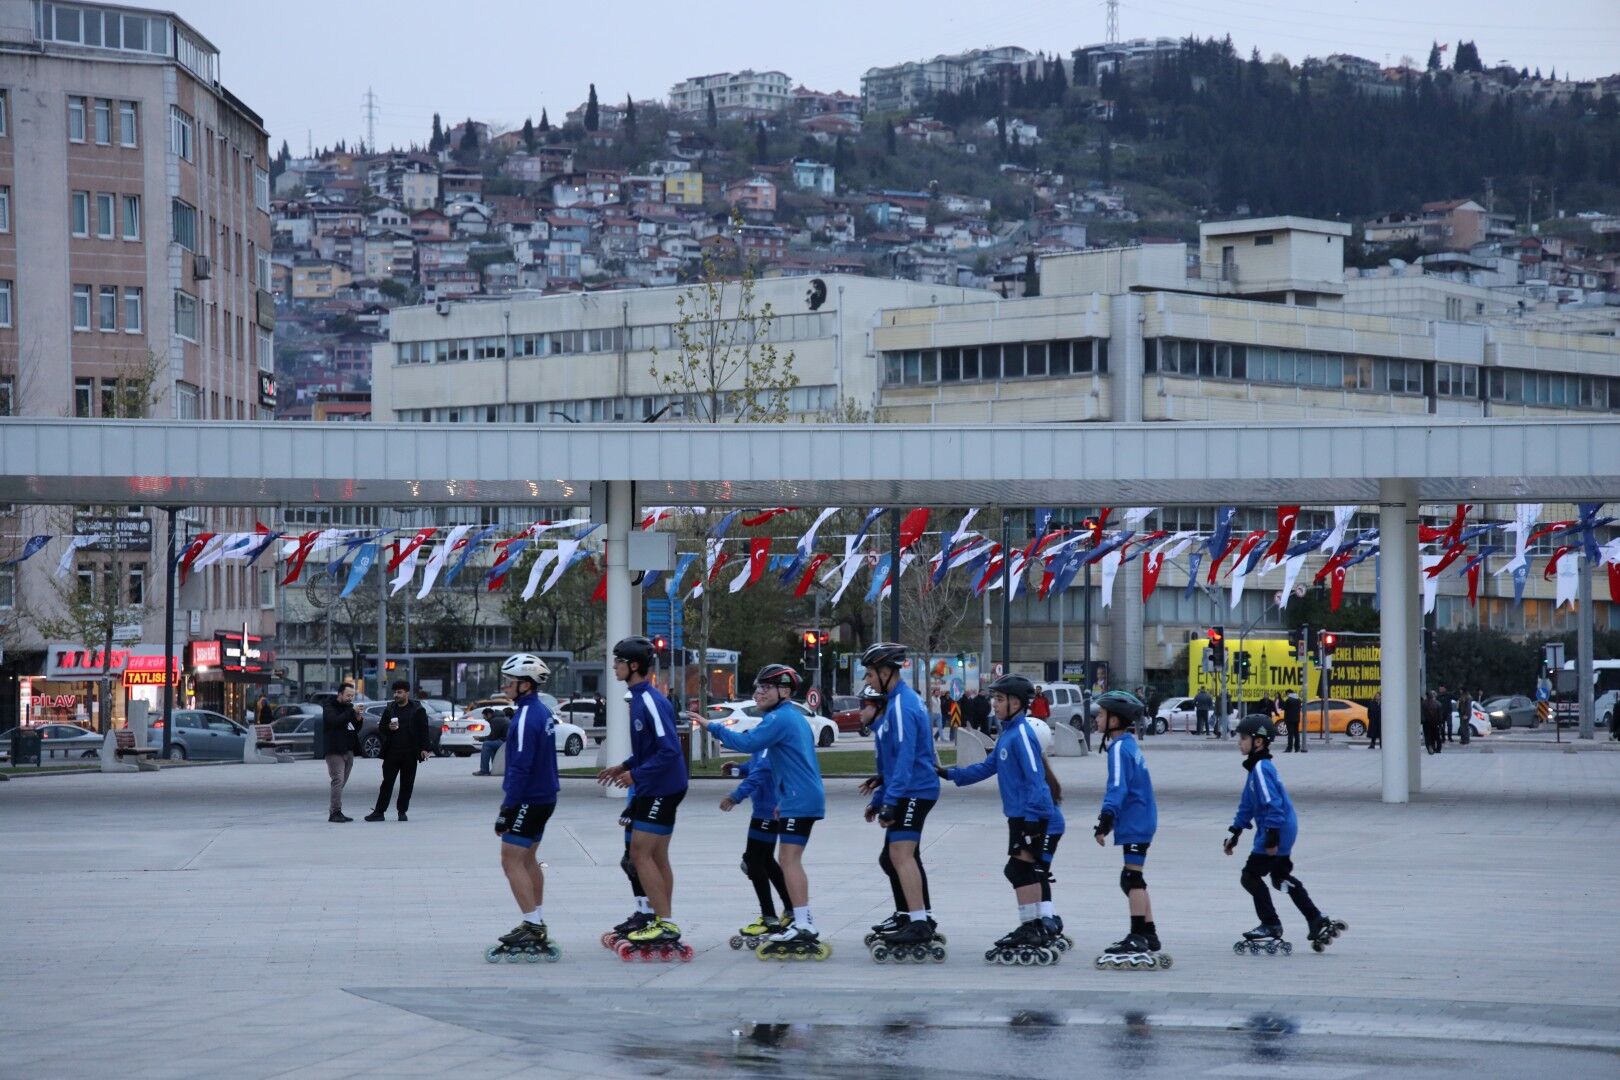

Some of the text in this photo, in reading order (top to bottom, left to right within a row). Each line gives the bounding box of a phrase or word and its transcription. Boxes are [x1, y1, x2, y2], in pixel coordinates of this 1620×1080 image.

[128, 673, 176, 684] TATLISE
[1269, 665, 1304, 685] TIME
[31, 693, 76, 708] PİLAV
